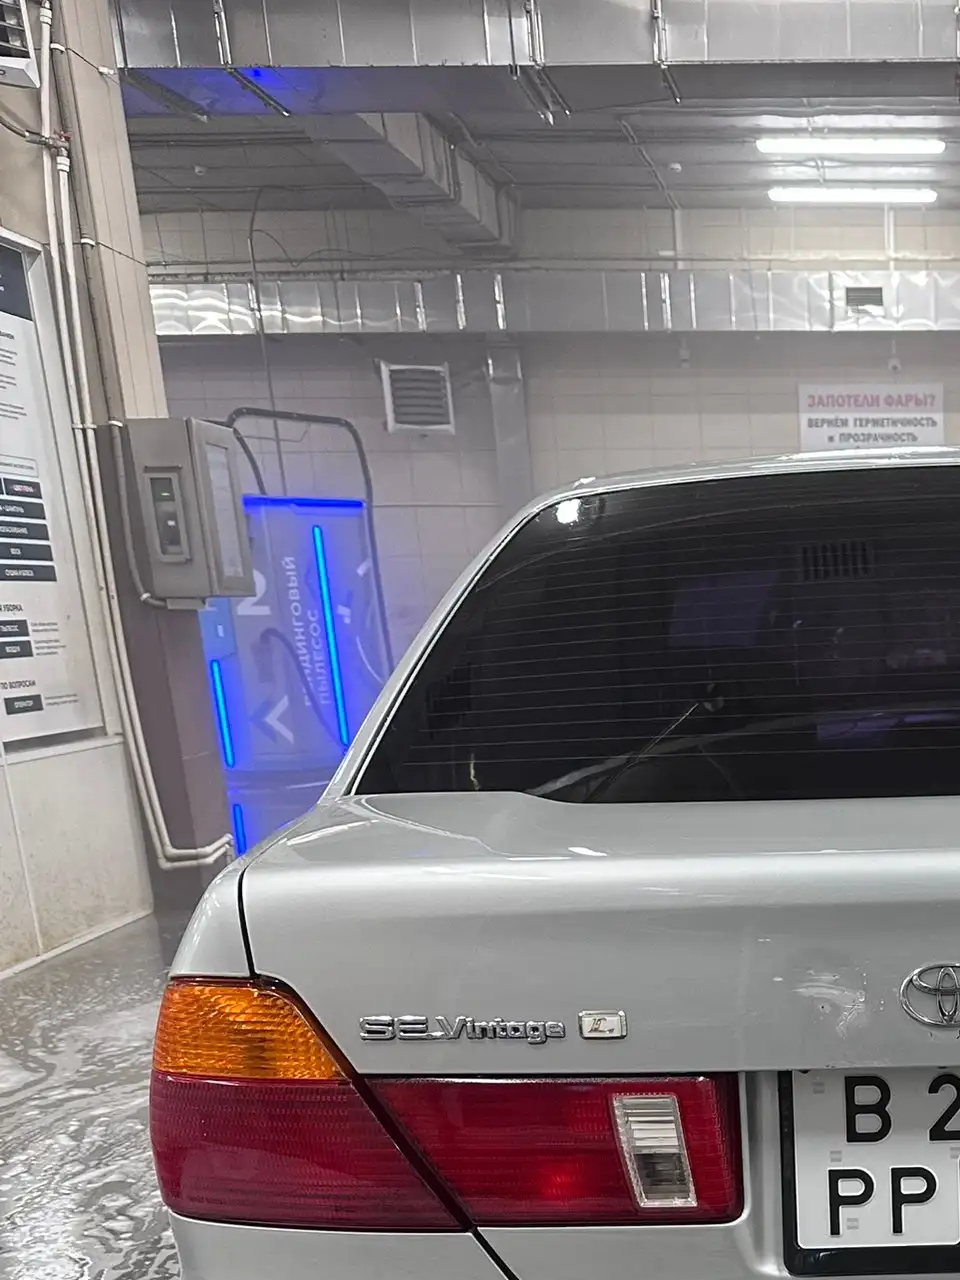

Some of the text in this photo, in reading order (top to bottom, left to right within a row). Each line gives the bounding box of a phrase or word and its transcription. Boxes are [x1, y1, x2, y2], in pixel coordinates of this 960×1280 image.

[807, 394, 936, 408] ЗАПОТЕЛИ ФАРЫ?
[839, 432, 918, 443] ПРОЗРАЧНОСТЬ
